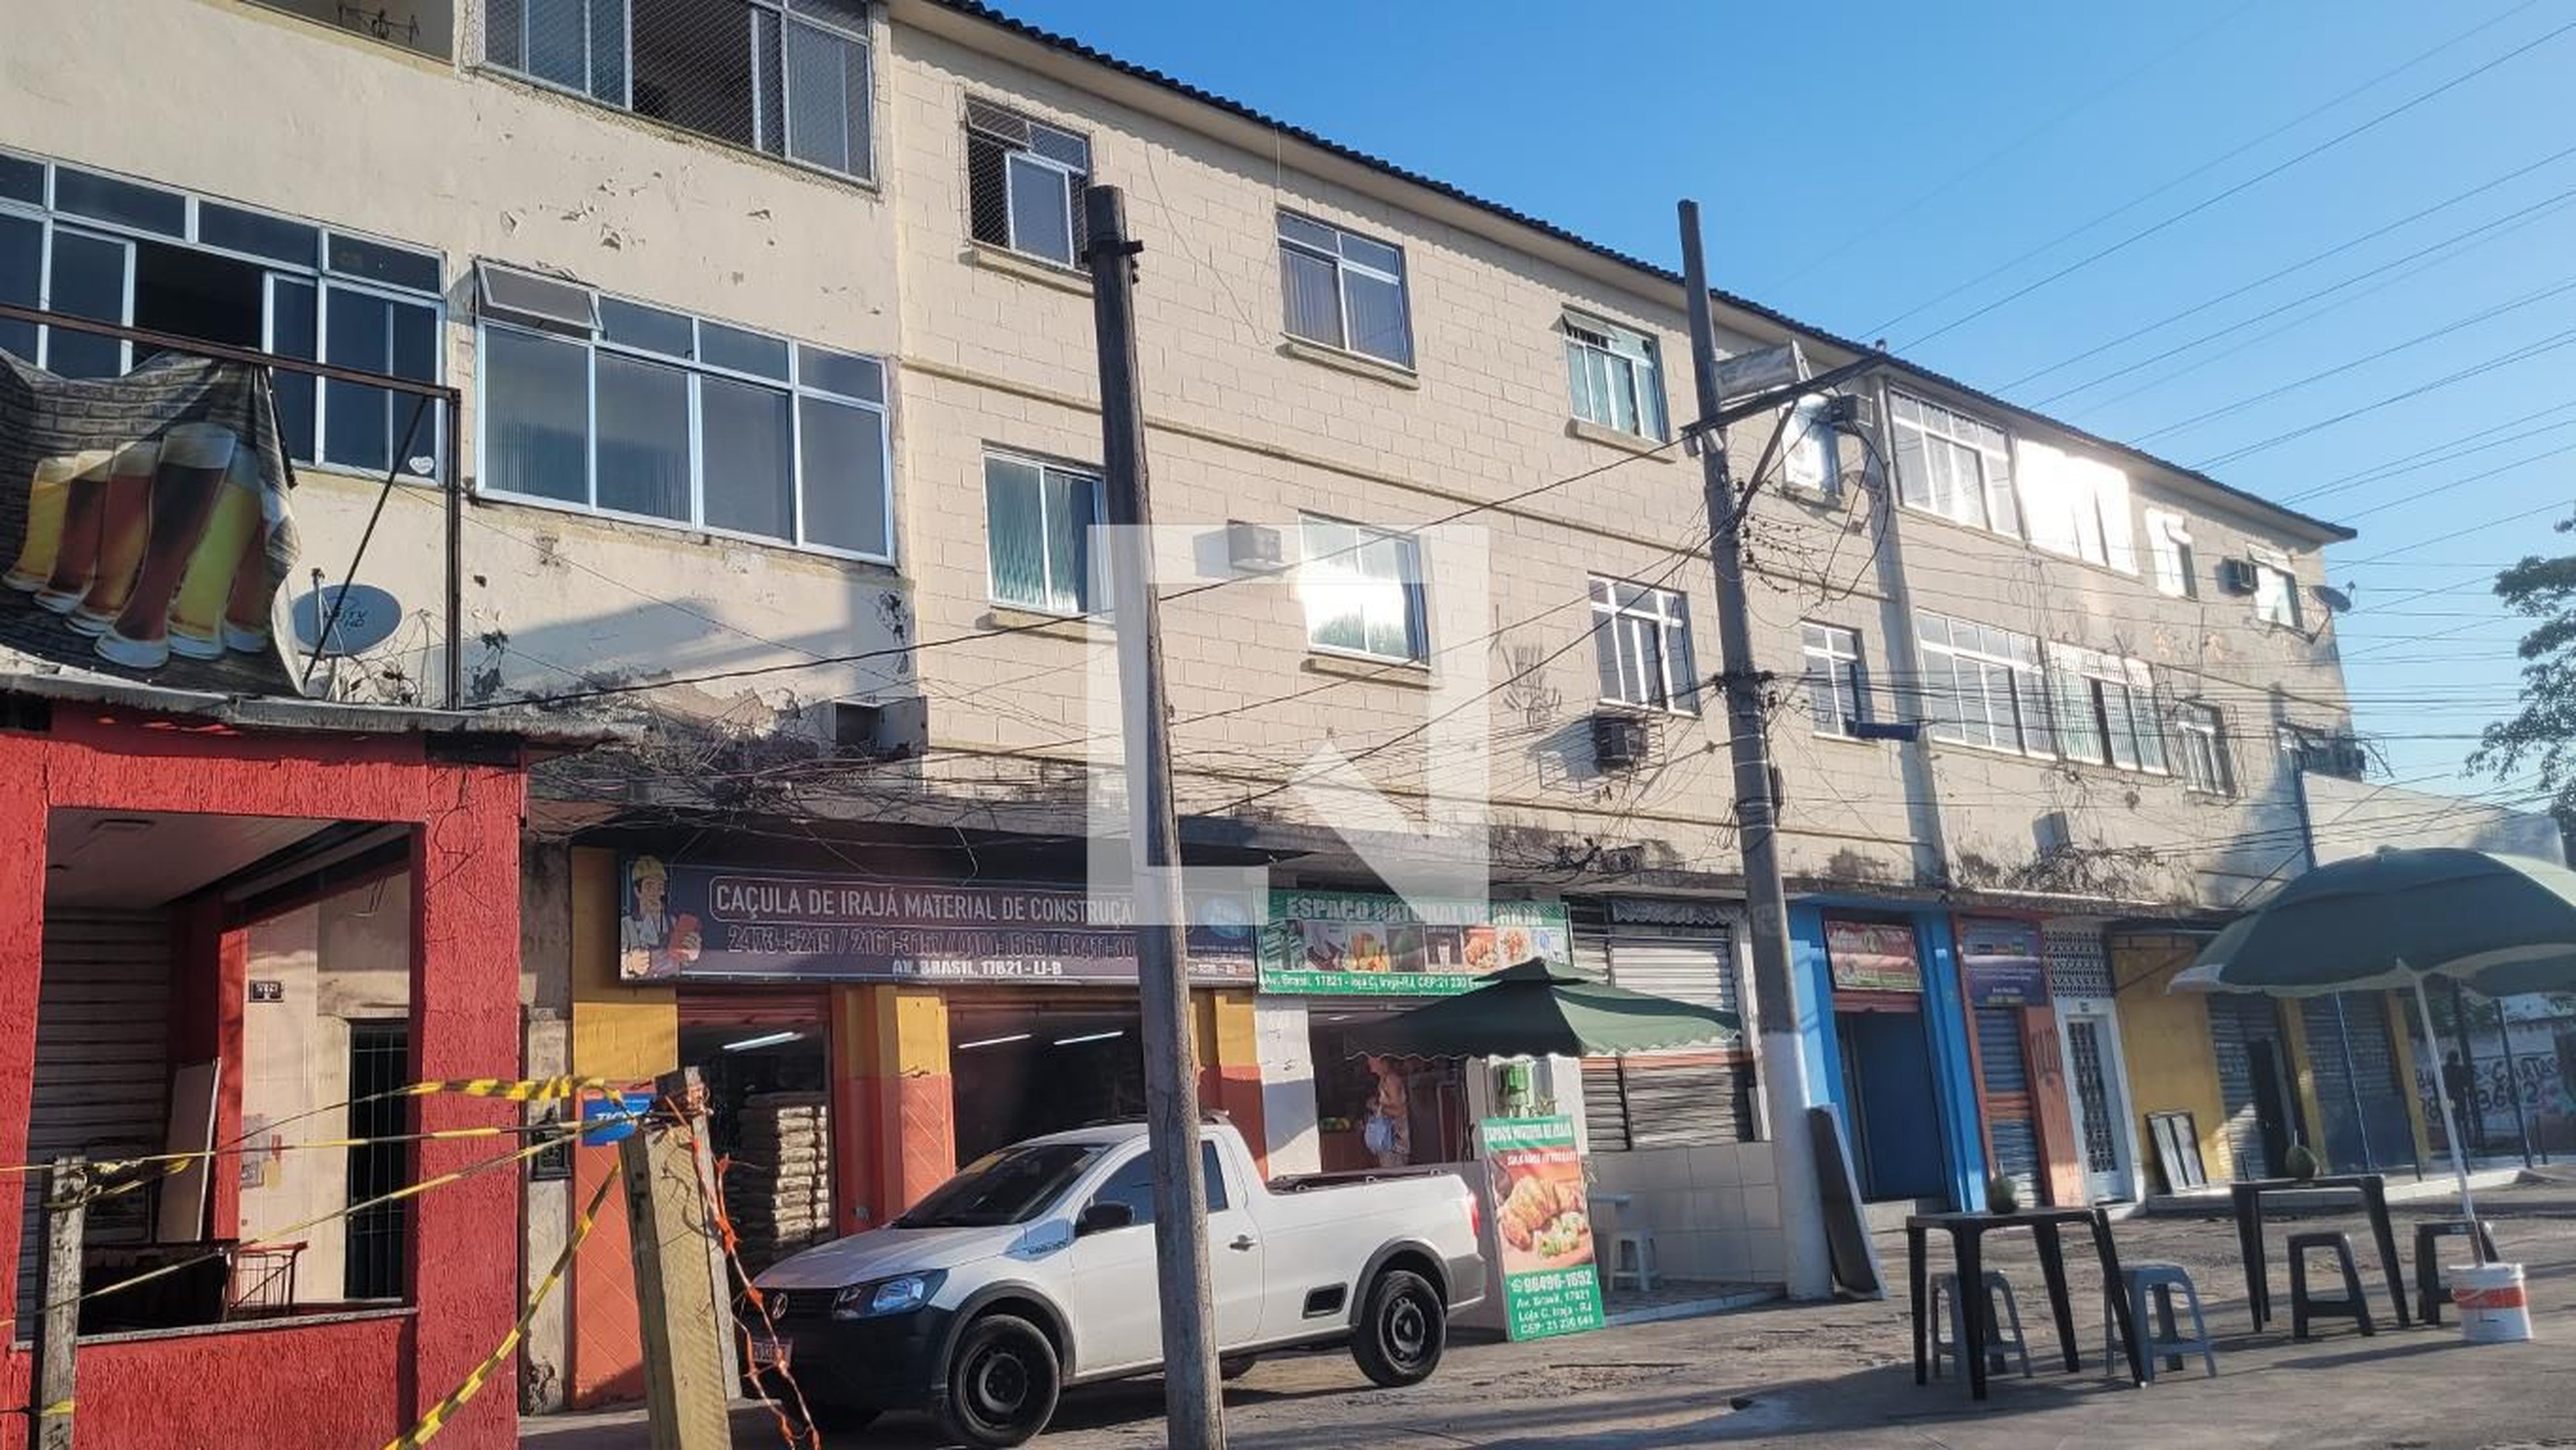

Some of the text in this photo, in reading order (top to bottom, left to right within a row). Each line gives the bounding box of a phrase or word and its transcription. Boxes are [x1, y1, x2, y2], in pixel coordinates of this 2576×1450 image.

[716, 885, 1136, 929] CAÇULA DE IRAJÁ MATERIAL DE CONSTRUÇÃ
[1287, 897, 1368, 921] ESPAÇO
[893, 960, 916, 975] AV.
